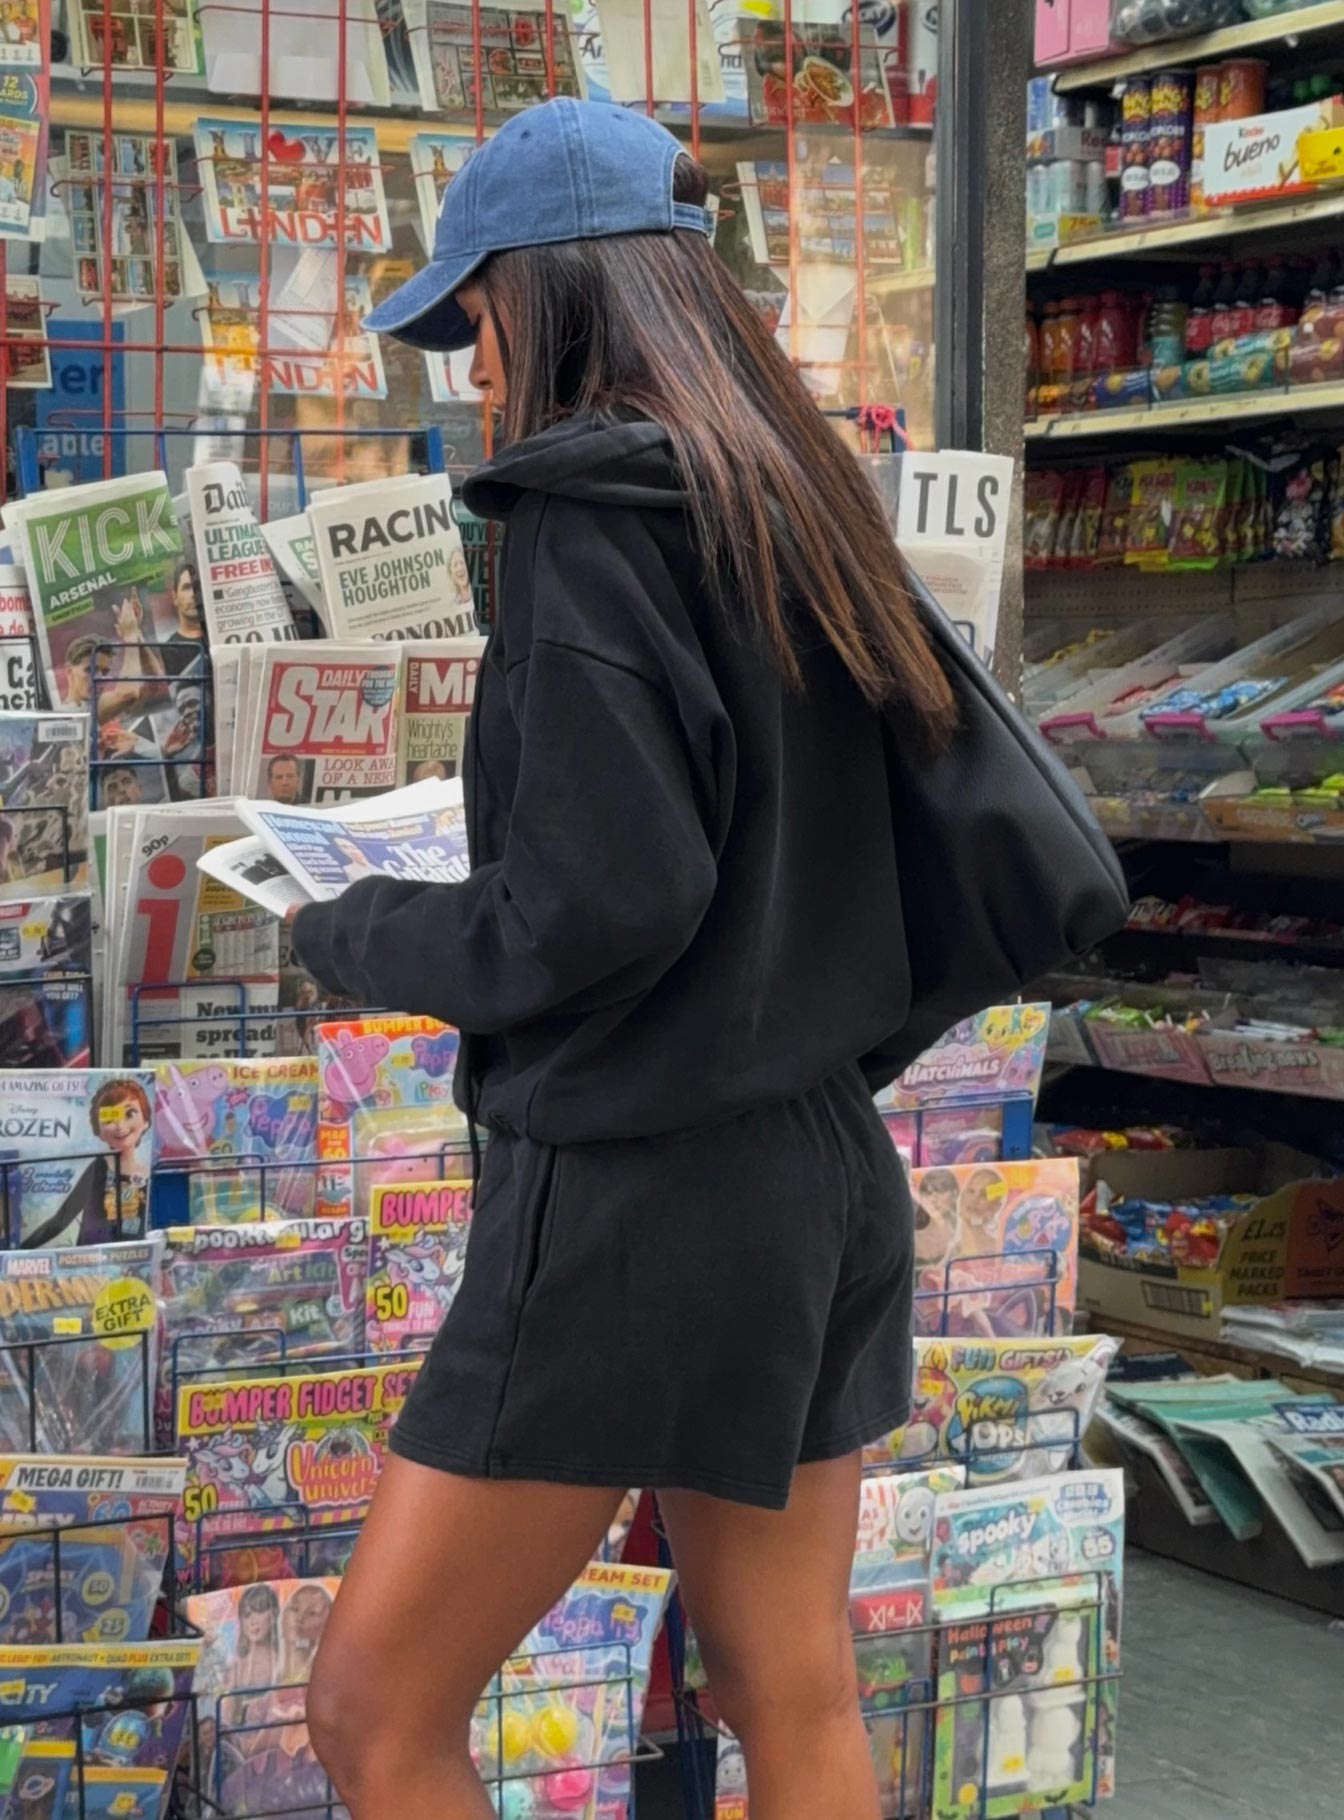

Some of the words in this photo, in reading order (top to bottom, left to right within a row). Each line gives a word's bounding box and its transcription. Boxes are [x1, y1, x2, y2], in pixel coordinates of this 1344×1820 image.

[1223, 134, 1280, 172] bueno
[913, 472, 998, 538] TLS
[35, 493, 180, 585] KICK
[328, 500, 451, 558] RACIN
[210, 560, 258, 580] FREE
[339, 568, 368, 590] EVE
[374, 548, 445, 581] JOHNSON
[50, 571, 117, 609] ARSENAL
[343, 572, 430, 607] HOUGHTON
[321, 669, 365, 687] DAILY
[409, 662, 420, 693] DAILY
[267, 665, 388, 747] STAR
[322, 772, 343, 784] OF
[346, 772, 358, 784] A
[324, 759, 364, 771] LOOK
[141, 833, 170, 857] 90p
[385, 843, 447, 868] The
[234, 1066, 259, 1079] ICE
[7, 1258, 50, 1275] MARVEL
[1240, 1249, 1277, 1263] PRICE
[1230, 1266, 1284, 1281] MARKED
[95, 1293, 151, 1322] EXTRA
[375, 1283, 409, 1322] 50
[103, 1308, 144, 1331] GIFT
[299, 1376, 377, 1419] FIDGET
[17, 1467, 72, 1488] MEGA
[77, 1467, 124, 1489] GIFT!
[291, 1443, 373, 1485] Unicorn
[183, 1482, 219, 1524] 50
[958, 1509, 1038, 1553] spooky
[630, 1573, 663, 1587] SET
